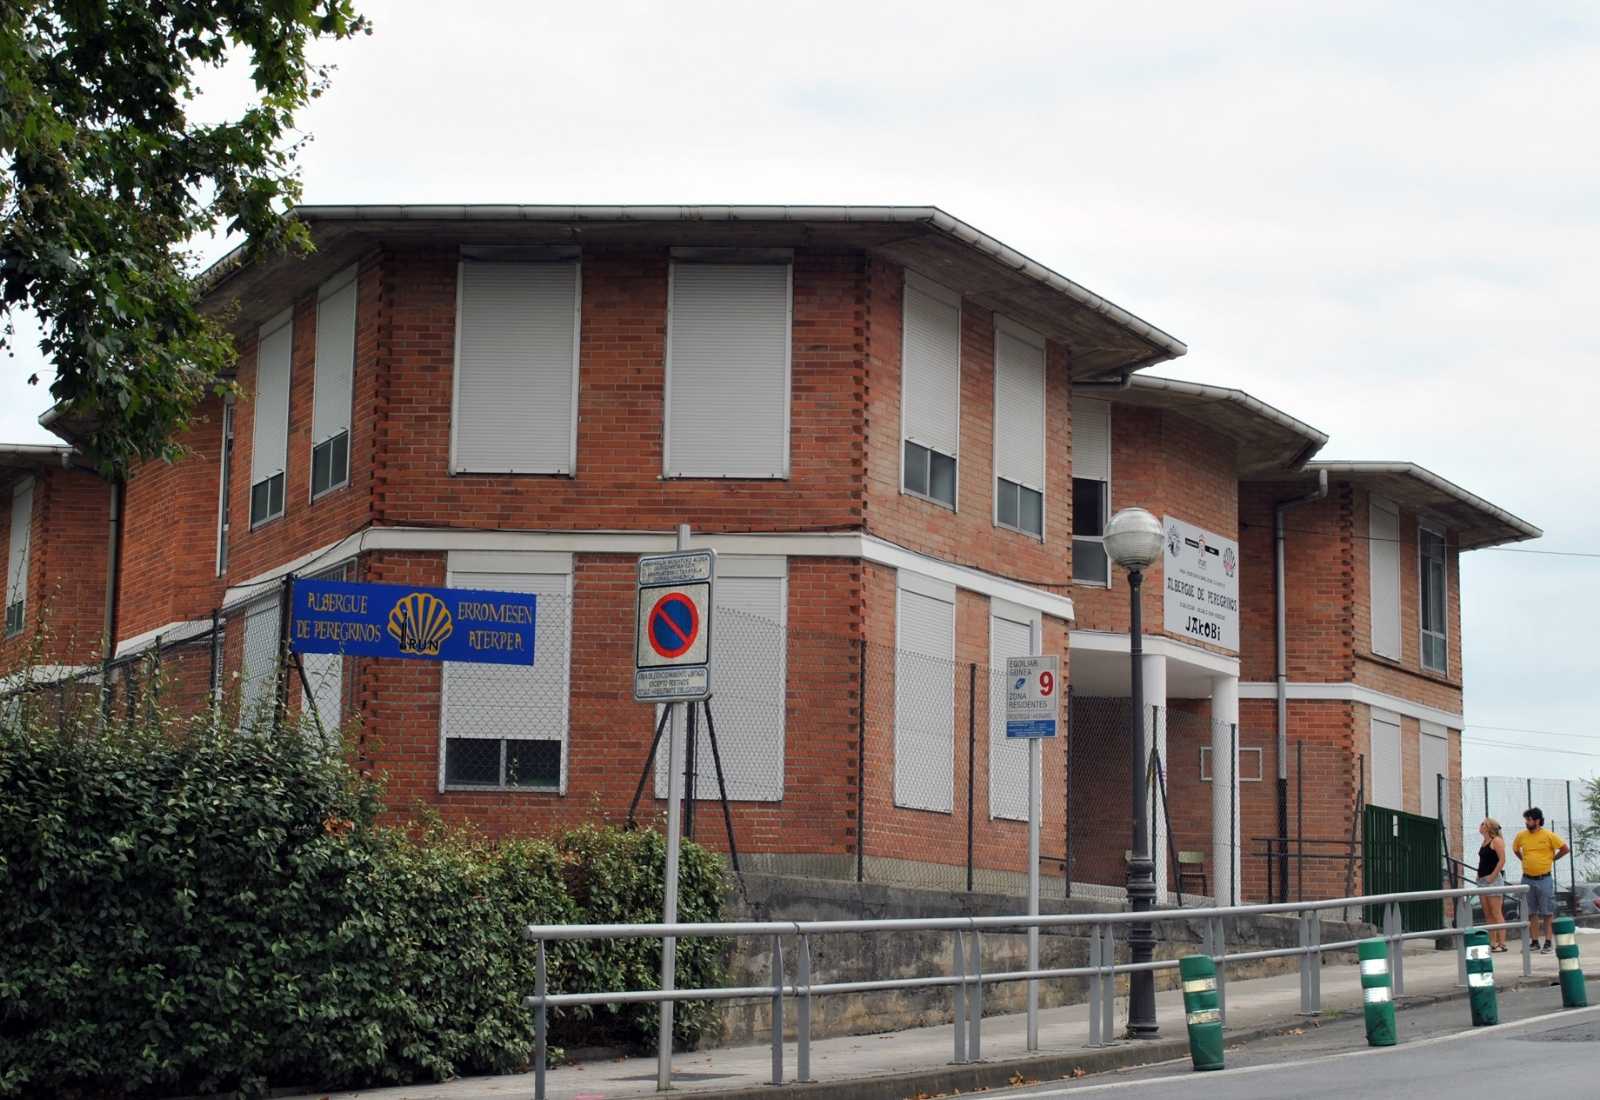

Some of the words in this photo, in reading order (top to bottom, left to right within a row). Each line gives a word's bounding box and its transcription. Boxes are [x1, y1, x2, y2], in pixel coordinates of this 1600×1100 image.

[307, 592, 369, 615] ALBERGUE
[1167, 577, 1196, 598] ALBERGUE
[1197, 587, 1206, 601] DE
[1207, 590, 1238, 612] PEREGRINOS
[458, 601, 533, 625] ERROMESEN
[296, 619, 311, 639] DE
[314, 620, 382, 643] PEREGRINOS
[468, 630, 525, 652] ATERPEA
[1039, 671, 1054, 697] 9
[1009, 692, 1027, 701] ZONA
